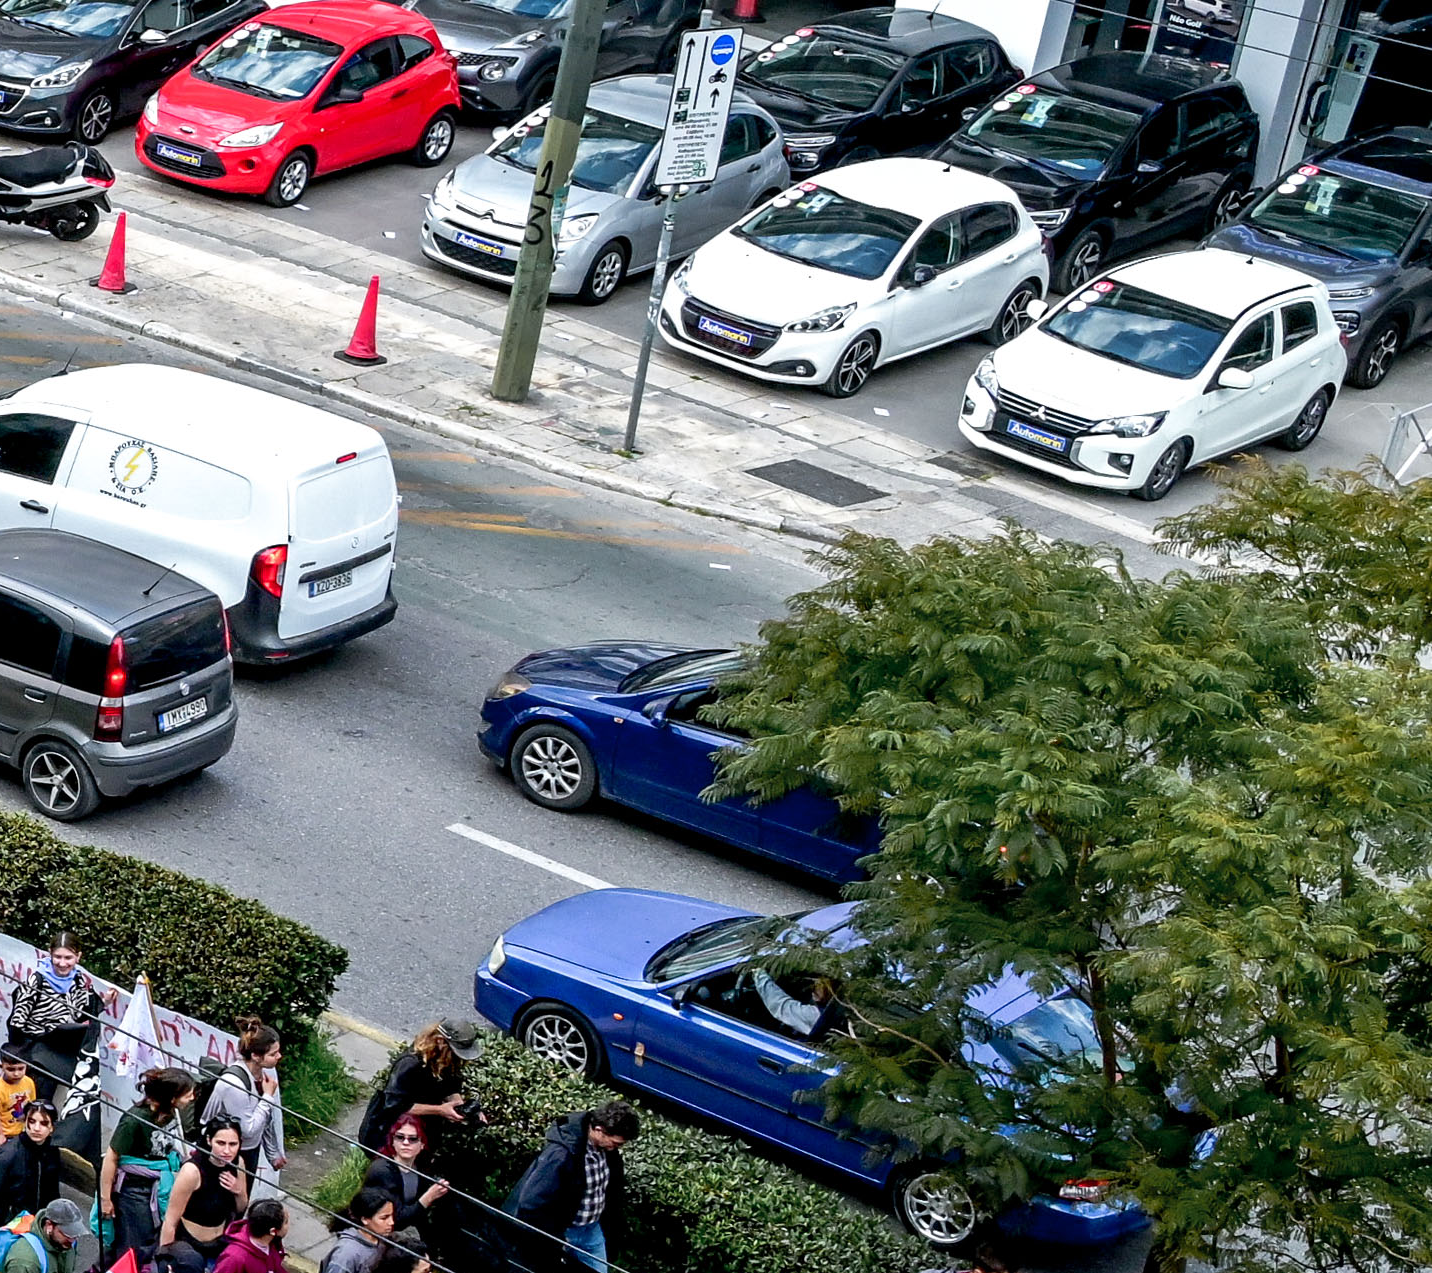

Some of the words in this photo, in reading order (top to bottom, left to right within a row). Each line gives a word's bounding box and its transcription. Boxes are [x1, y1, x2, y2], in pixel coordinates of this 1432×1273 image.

[457, 233, 502, 256] Automarin
[703, 319, 749, 344] Automarin
[1010, 422, 1063, 449] Automarin
